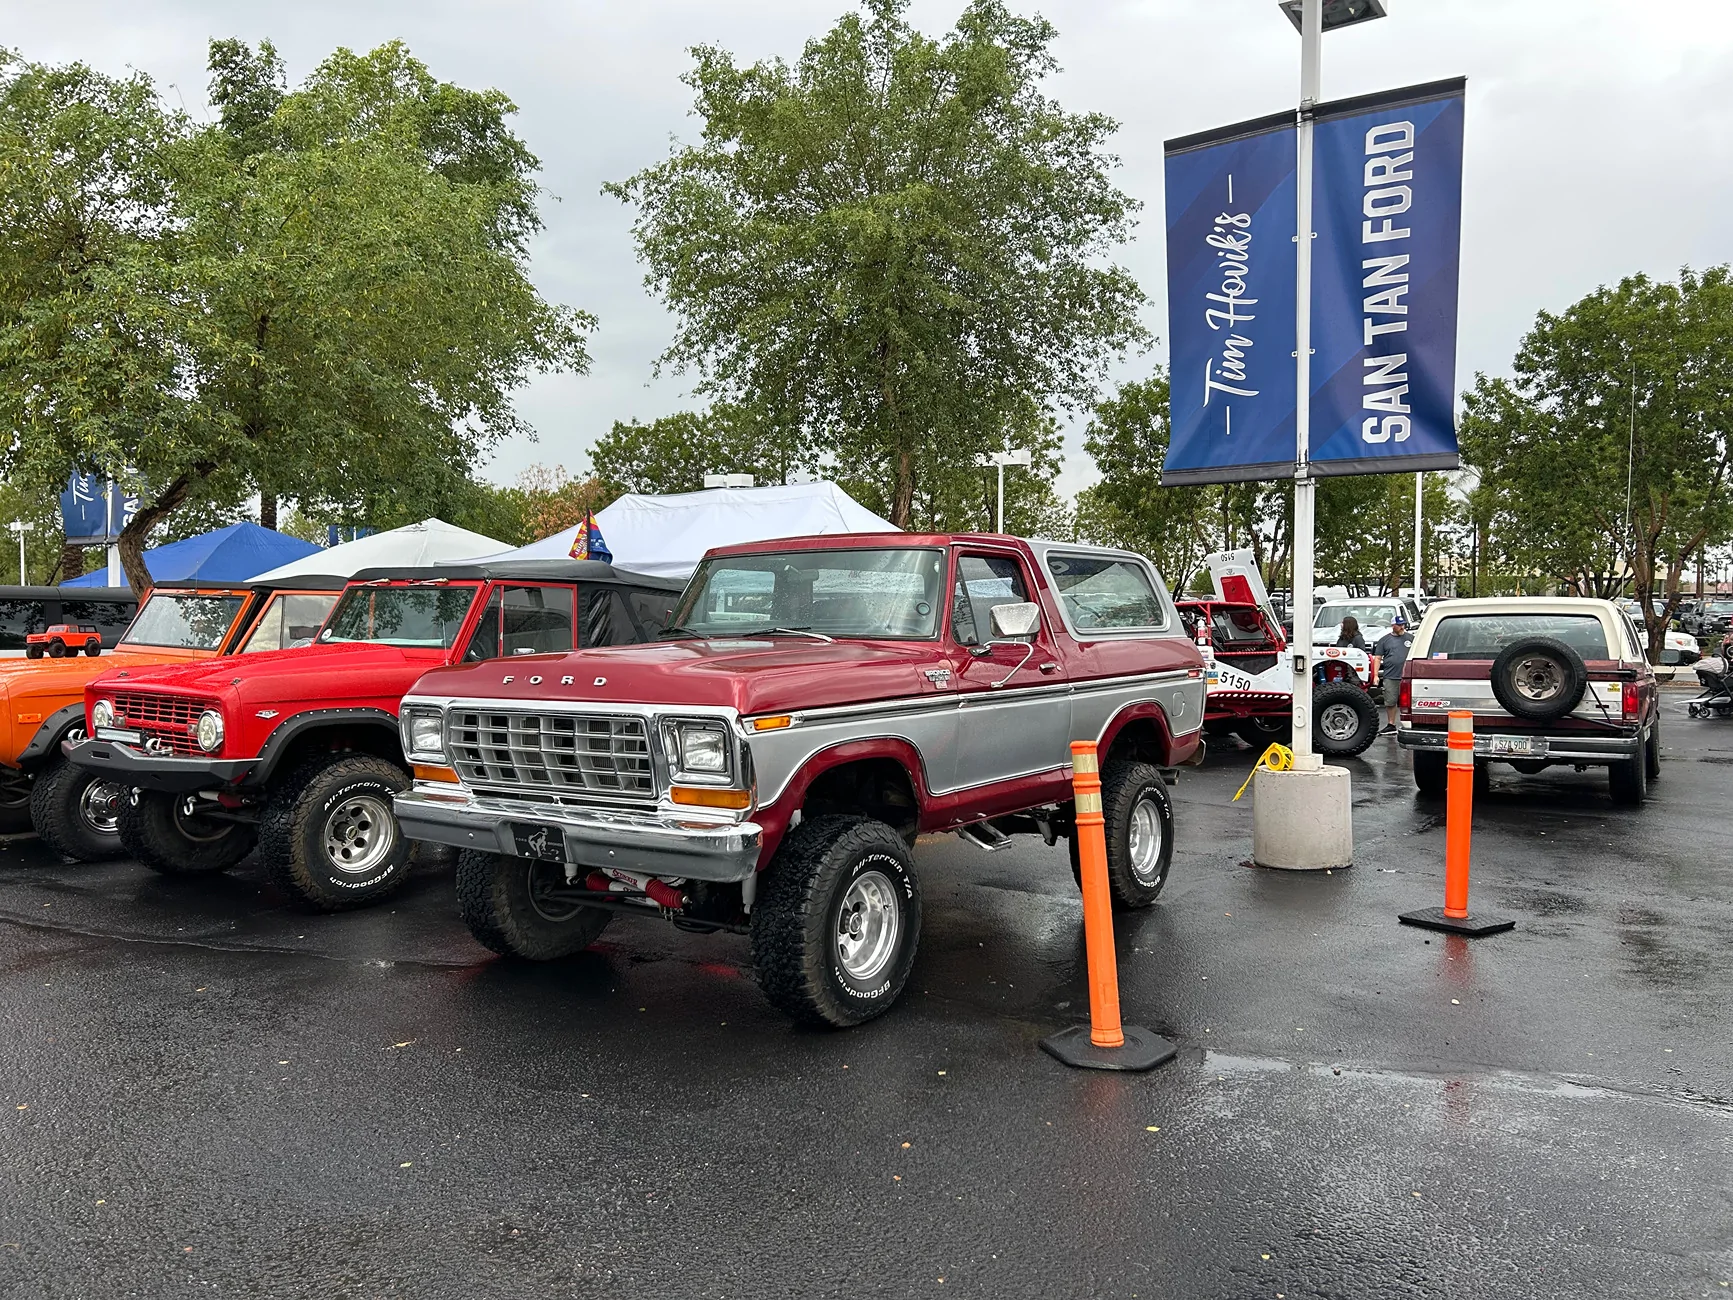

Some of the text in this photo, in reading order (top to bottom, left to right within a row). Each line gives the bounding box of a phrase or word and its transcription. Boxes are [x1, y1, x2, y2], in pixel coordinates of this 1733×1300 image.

[1362, 120, 1415, 444] SAN TAN FORD
[1203, 212, 1259, 407] Tim Hovik's
[1220, 552, 1235, 562] 5150
[502, 675, 607, 686] FORD
[1220, 671, 1251, 691] 5150
[324, 781, 381, 811] All-Terrain
[329, 865, 394, 889] BFGoodrich
[852, 854, 913, 899] All-Terrain T/A
[834, 966, 891, 999] BFGoodrich
